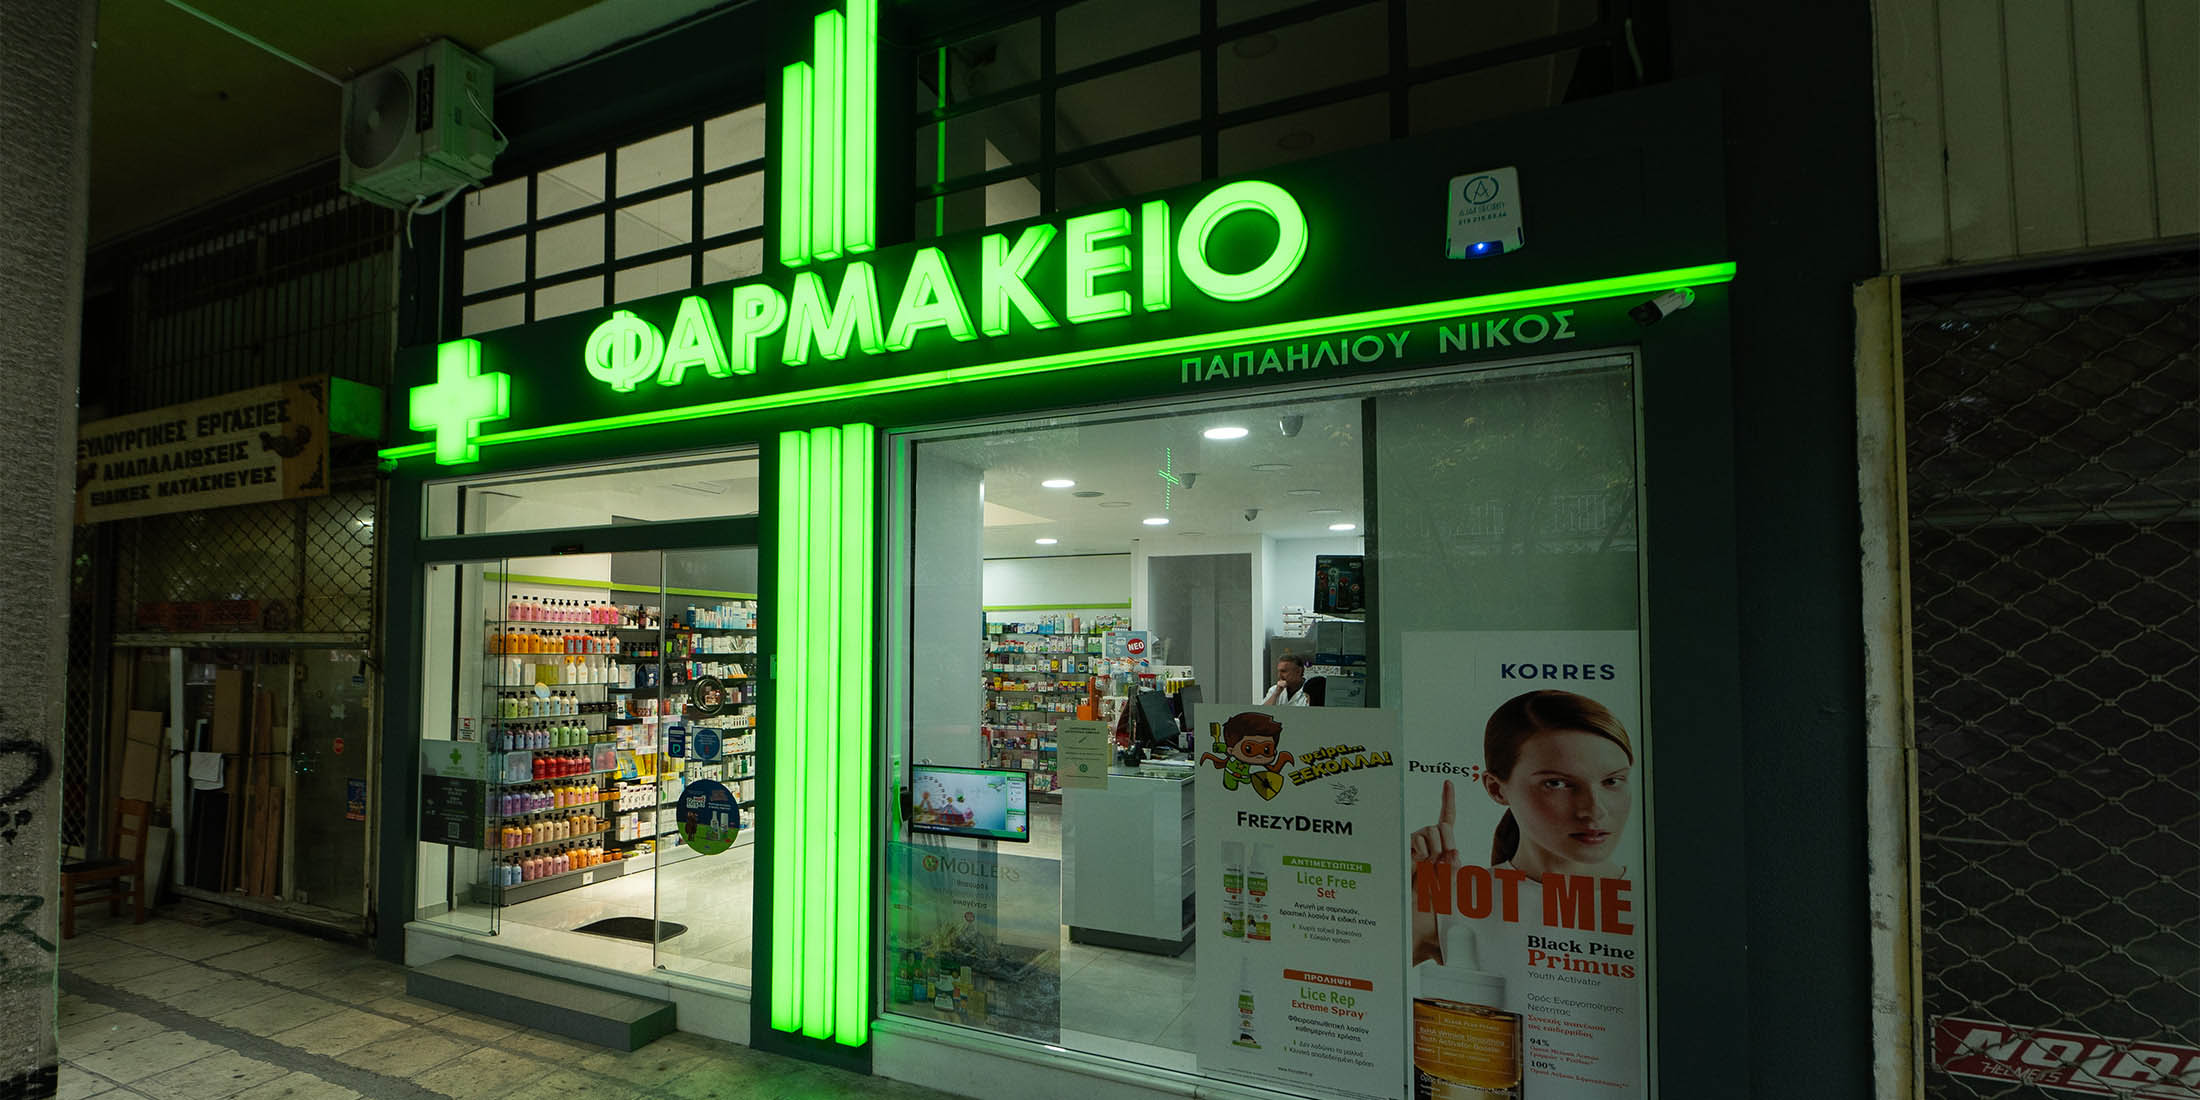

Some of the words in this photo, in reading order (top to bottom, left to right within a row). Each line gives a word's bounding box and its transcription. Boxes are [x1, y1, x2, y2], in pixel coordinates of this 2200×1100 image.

[584, 180, 1309, 392] ΦΑΡΜΑΚΕΙΟ
[1181, 330, 1410, 384] ΠΑΠΑΗΛΙΟΥ
[1439, 309, 1576, 353] ΝΙΚΟΣ
[196, 399, 291, 437] ΕΡΓΑΣΙΕΣ
[103, 440, 249, 481] ΑΝΑΠΑΛΑΙΩΣΕΙΣ
[157, 465, 277, 497] ΚΑΤΑΣΚΕΥΕΣ
[1501, 663, 1615, 680] KORRES
[1288, 751, 1394, 786] ΞΕΚΟΛΛΑ!
[1297, 871, 1323, 886] Lice
[1327, 875, 1357, 889] Free
[1317, 887, 1336, 899] Set
[1416, 861, 1526, 923] NOT
[1542, 871, 1634, 936] ME
[1528, 935, 1583, 954] Black
[1589, 942, 1634, 960] Pine
[1528, 949, 1636, 979] Primus
[1304, 973, 1352, 987] ΠΡΟΛΗΨΗ
[1528, 970, 1556, 981] Youth
[1557, 974, 1601, 987] Activator
[1291, 1000, 1329, 1013] Extreme
[1300, 987, 1327, 1000] Lice
[1330, 991, 1355, 1008] Rep
